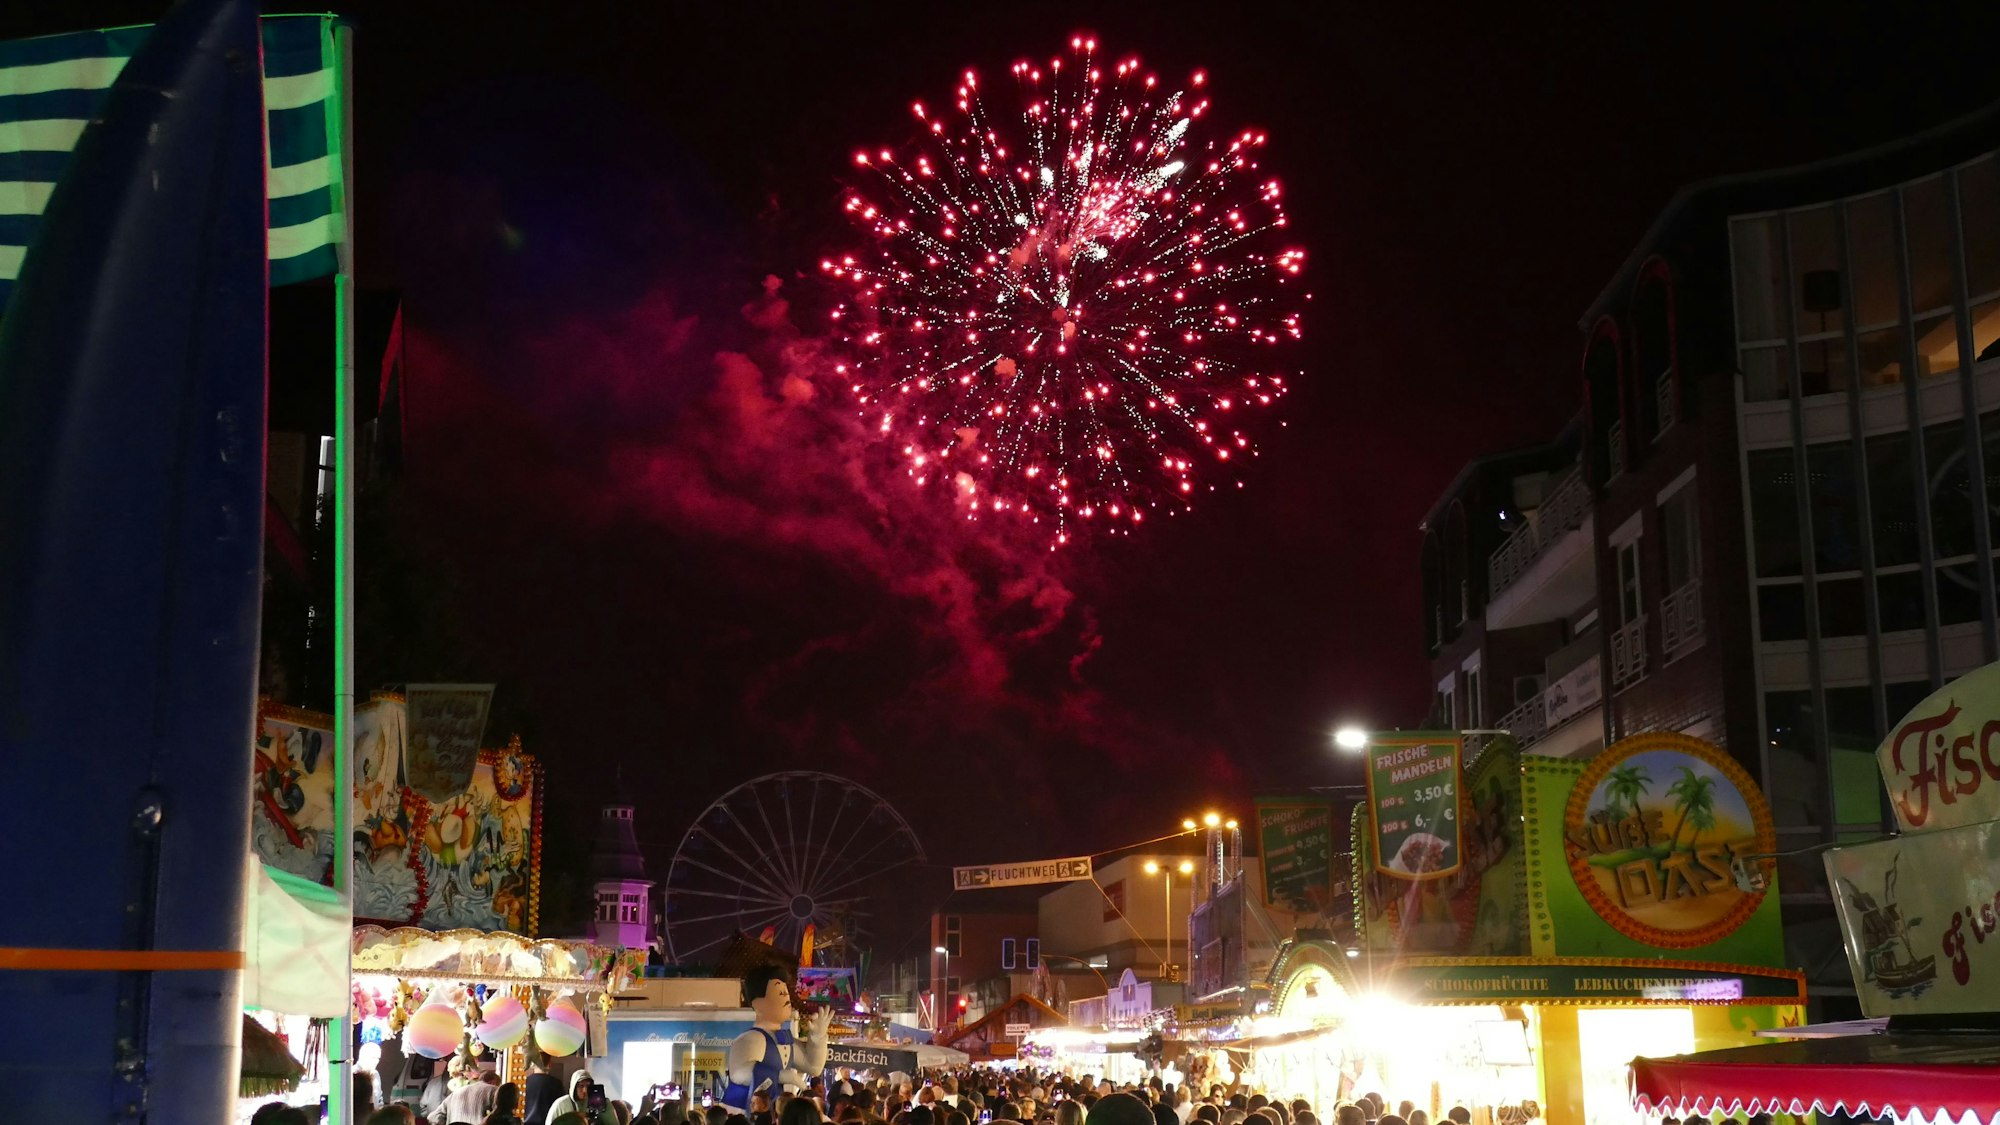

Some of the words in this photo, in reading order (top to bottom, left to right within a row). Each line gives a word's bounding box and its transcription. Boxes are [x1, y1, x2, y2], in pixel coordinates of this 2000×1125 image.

[1376, 744, 1428, 770] FRISCHE
[1390, 755, 1452, 784] MANDELN
[1381, 797, 1395, 808] 100
[1414, 785, 1442, 803] 3,50
[1443, 783, 1454, 796] €
[1382, 822, 1398, 834] 200
[1414, 814, 1432, 827] 6,-
[1443, 808, 1455, 820] €
[991, 864, 1056, 881] FLUCHTWEG
[1423, 975, 1549, 991] SCHOKOFRÜCHTE
[1574, 977, 1724, 991] LEBKUCHENHER
[827, 1048, 889, 1066] Backfisch
